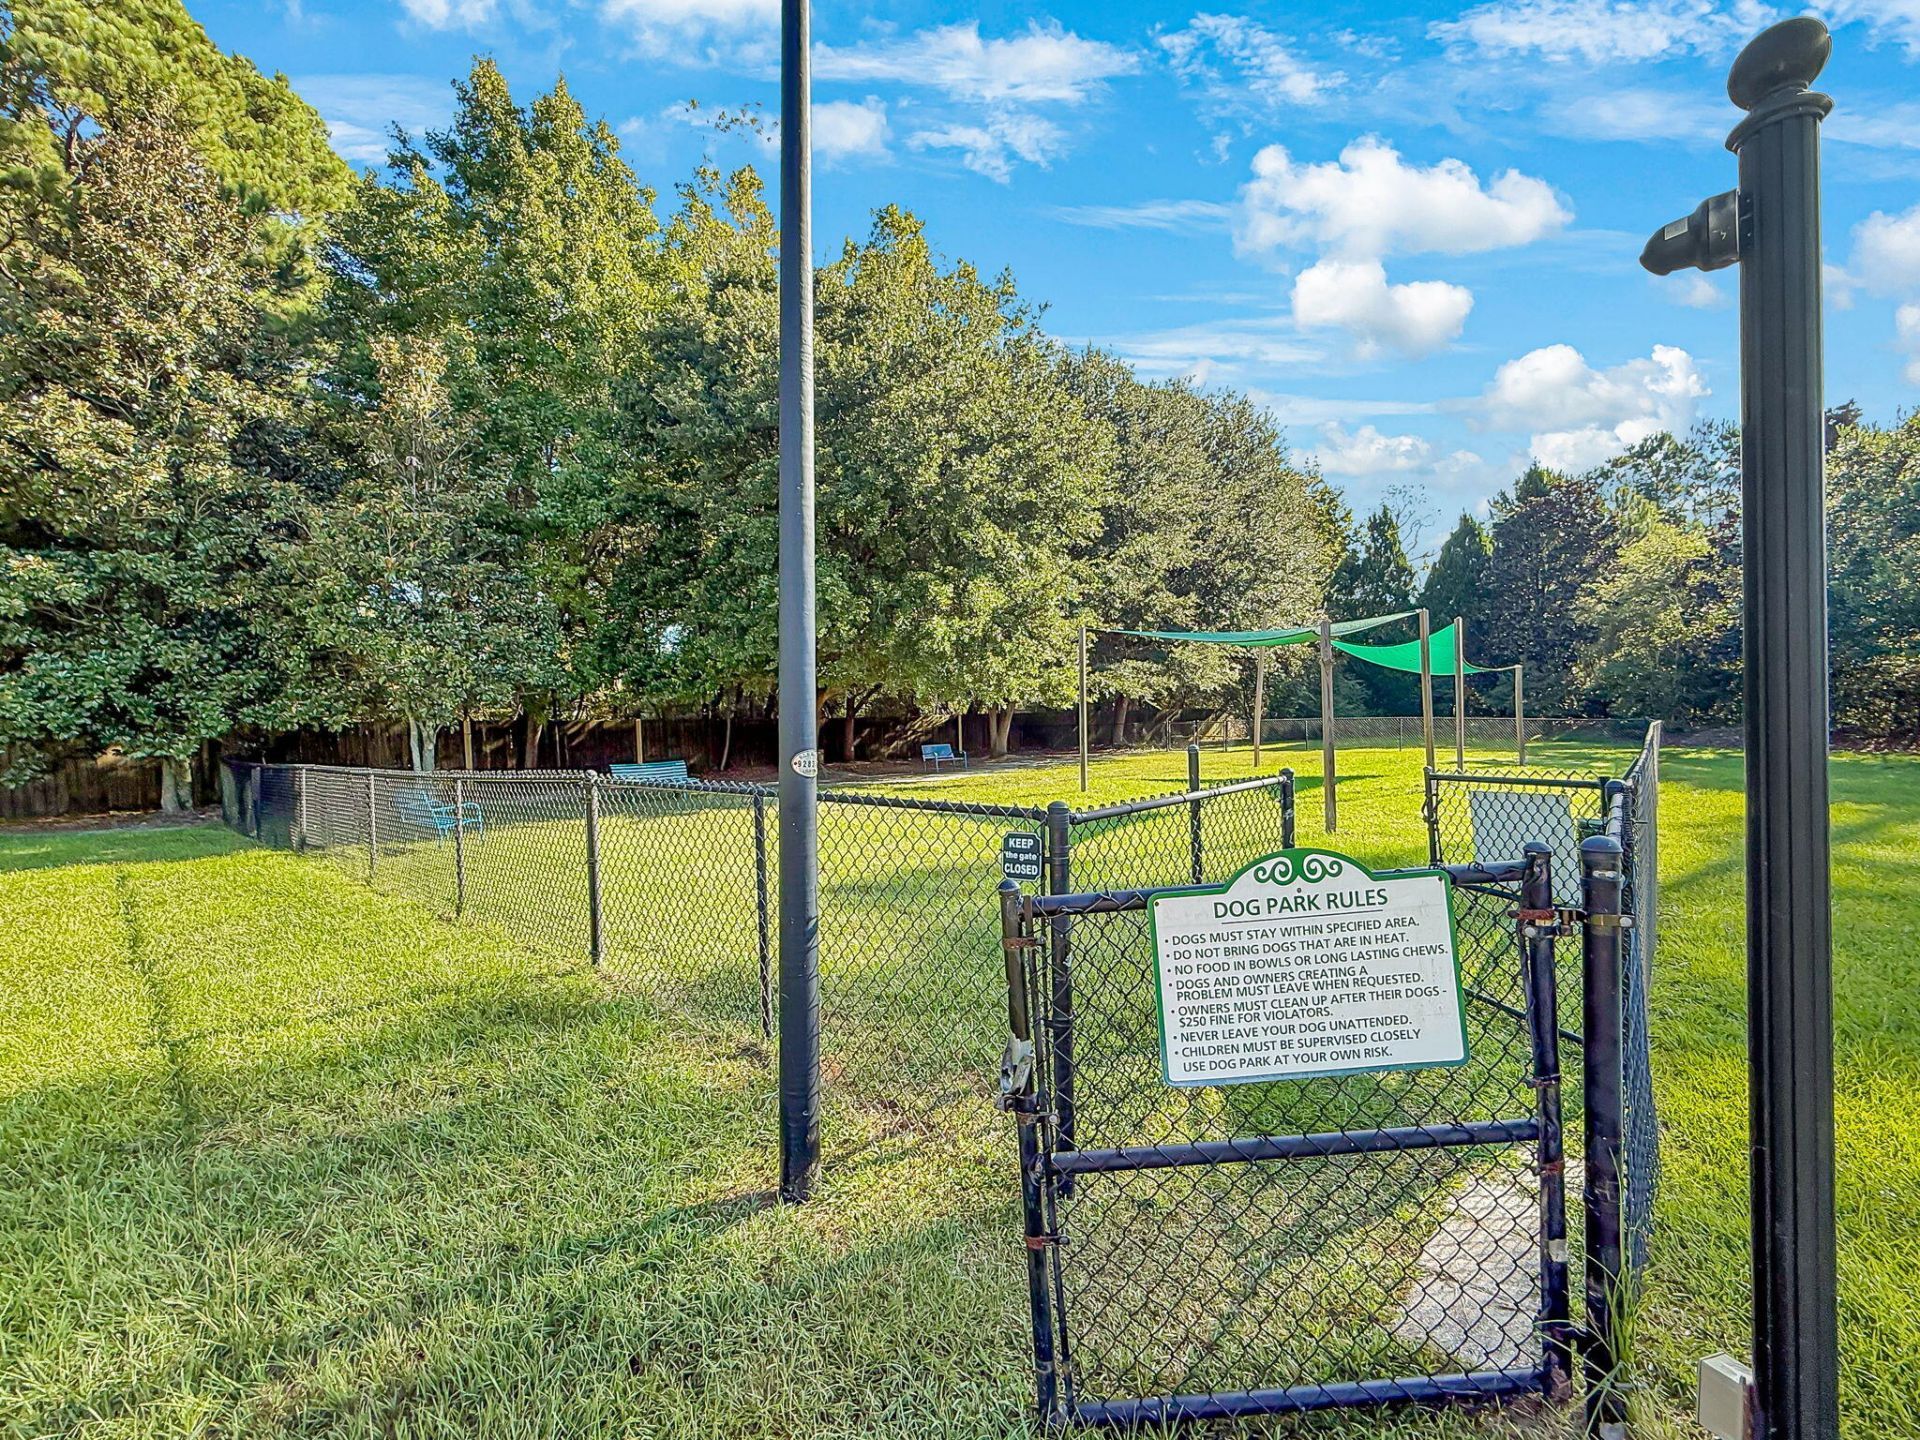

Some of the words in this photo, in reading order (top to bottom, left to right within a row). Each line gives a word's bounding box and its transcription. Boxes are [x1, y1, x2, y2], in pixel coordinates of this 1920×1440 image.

[1009, 838, 1033, 848] KEEP
[1004, 863, 1038, 875] CLOSED
[1214, 899, 1260, 918] DOG
[1267, 894, 1321, 914] PARK
[1326, 888, 1388, 909] RULES
[1172, 934, 1206, 945] DOGS
[1210, 931, 1243, 942] MUST
[1247, 928, 1276, 939] STAY
[1280, 924, 1323, 937] WITHIN
[1327, 920, 1381, 934] SPECIFIED
[1385, 917, 1419, 928] AREA.
[1173, 949, 1191, 960] DO
[1195, 947, 1221, 958] NOT
[1224, 944, 1259, 956] BRING
[1263, 942, 1296, 953] DOGS
[1299, 939, 1331, 950] THAT
[1334, 937, 1356, 948] ARE
[1360, 936, 1371, 946] IN
[1375, 932, 1409, 944] HEAT.
[1175, 964, 1193, 975] NO
[1197, 962, 1230, 973] FOOD
[1234, 960, 1246, 971] IN
[1249, 957, 1291, 970] BOWLS
[1294, 956, 1311, 965] OR
[1315, 952, 1347, 964] LONG
[1351, 948, 1399, 961] LASTING
[1402, 944, 1448, 957] CHEWS.
[1176, 978, 1210, 990] DOGS
[1213, 976, 1240, 987] AND
[1243, 971, 1295, 985] OWNERS
[1298, 967, 1356, 981] CREATING
[1359, 966, 1368, 975] A
[1177, 988, 1233, 1001] PROBLEM
[1236, 985, 1270, 997] MUST
[1273, 982, 1310, 994] LEAVE
[1313, 979, 1349, 991] WHEN
[1353, 973, 1424, 988] REQUESTED.
[1178, 1003, 1230, 1016] OWNERS
[1233, 1000, 1268, 1012] MUST
[1270, 997, 1308, 1009] CLEAN
[1312, 996, 1327, 1006] UP
[1331, 992, 1366, 1004] AFTER
[1369, 989, 1402, 1001] THEIR
[1405, 986, 1440, 998] DOGS
[1179, 1016, 1206, 1028] $250
[1210, 1014, 1235, 1025] FINE
[1238, 1012, 1261, 1023] FOR
[1264, 1007, 1333, 1021] VIOLATORS.
[1181, 1030, 1219, 1042] NEVER
[1222, 1027, 1258, 1039] LEAVE
[1261, 1025, 1296, 1036] YOUR
[1299, 1022, 1326, 1033] DOG
[1330, 1015, 1412, 1031] UNATTENDED.
[1182, 1044, 1239, 1057] CHILDREN
[1243, 1041, 1277, 1053] MUST
[1280, 1039, 1294, 1049] BE
[1297, 1034, 1367, 1049] SUPERVISED
[1370, 1029, 1420, 1042] CLOSELY
[1183, 1061, 1205, 1072] USE
[1209, 1059, 1236, 1070] DOG
[1239, 1056, 1271, 1068] PARK
[1274, 1055, 1289, 1065] AT
[1293, 1052, 1327, 1063] YOUR
[1330, 1050, 1361, 1061] OWN
[1364, 1047, 1393, 1058] RISK.
